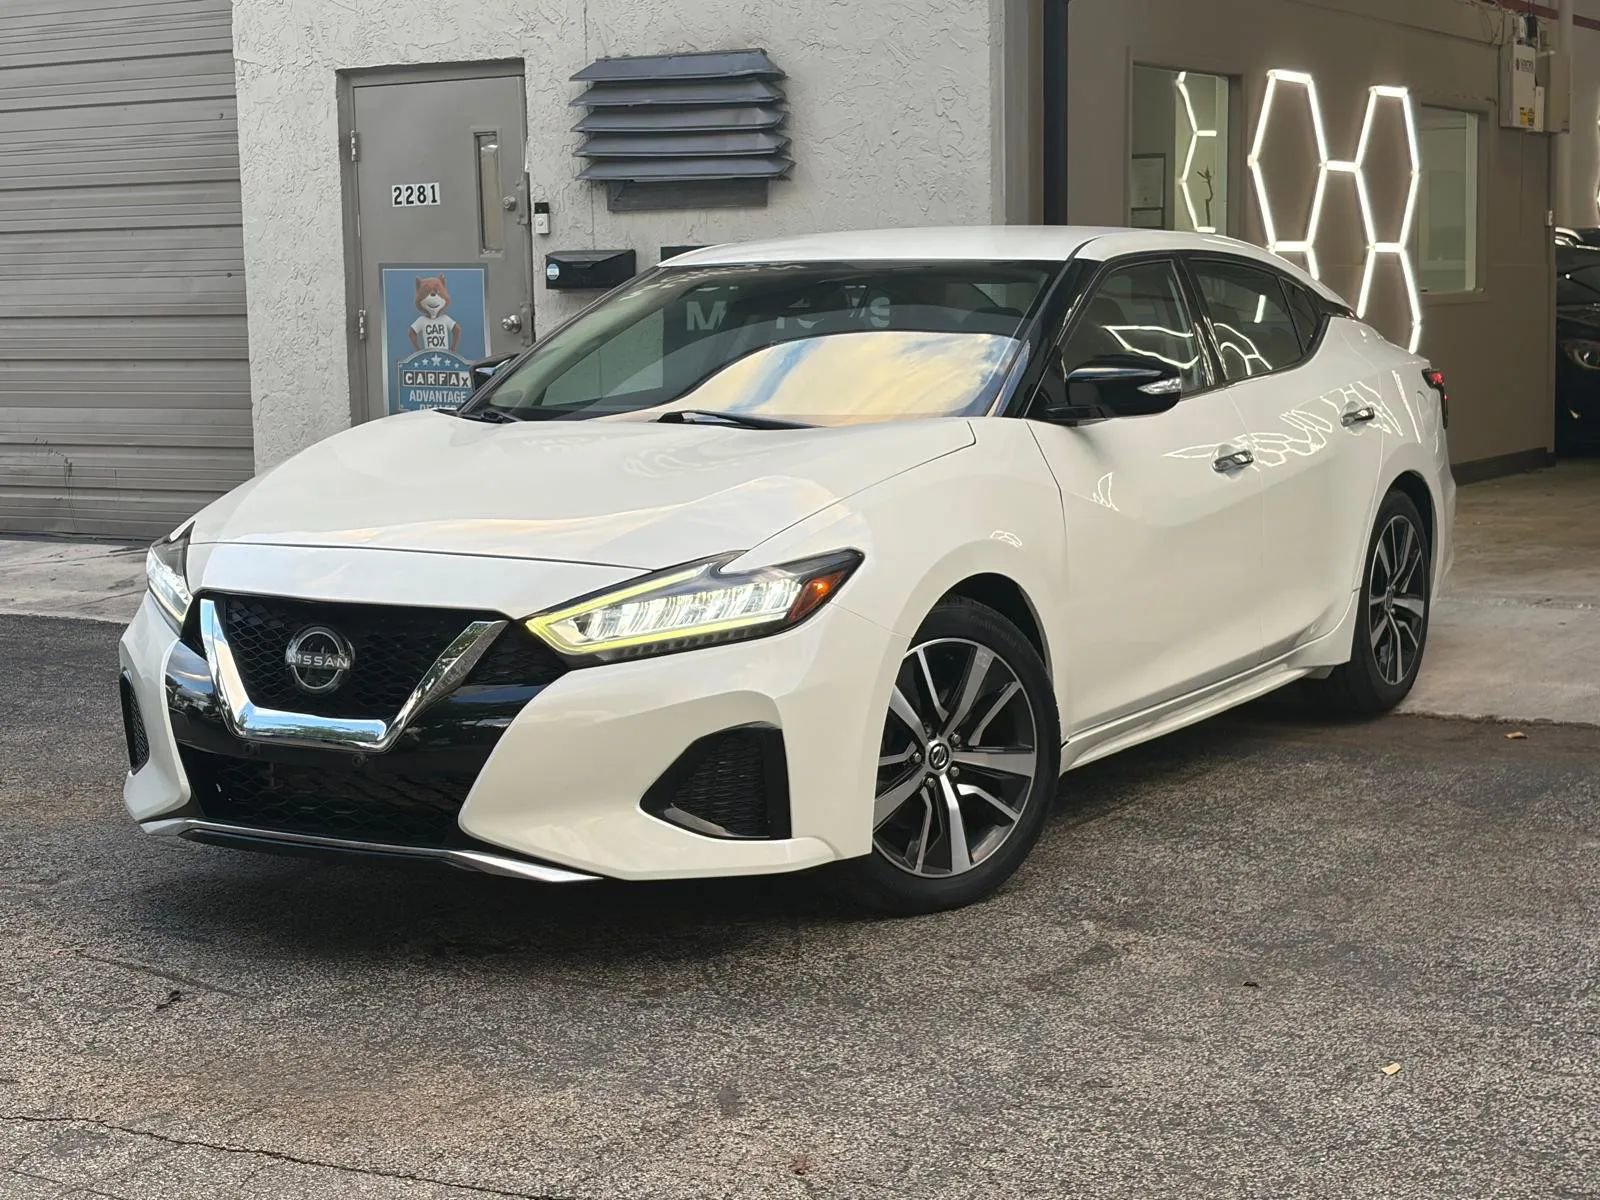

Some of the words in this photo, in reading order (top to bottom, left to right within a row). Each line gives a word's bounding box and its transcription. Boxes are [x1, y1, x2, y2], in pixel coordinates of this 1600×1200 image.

[393, 184, 438, 205] 2281
[425, 324, 446, 335] CAR
[426, 336, 446, 348] FOX
[405, 373, 470, 387] CARFAX
[409, 390, 466, 403] ADVANTAGE
[288, 653, 348, 667] NISSAN
